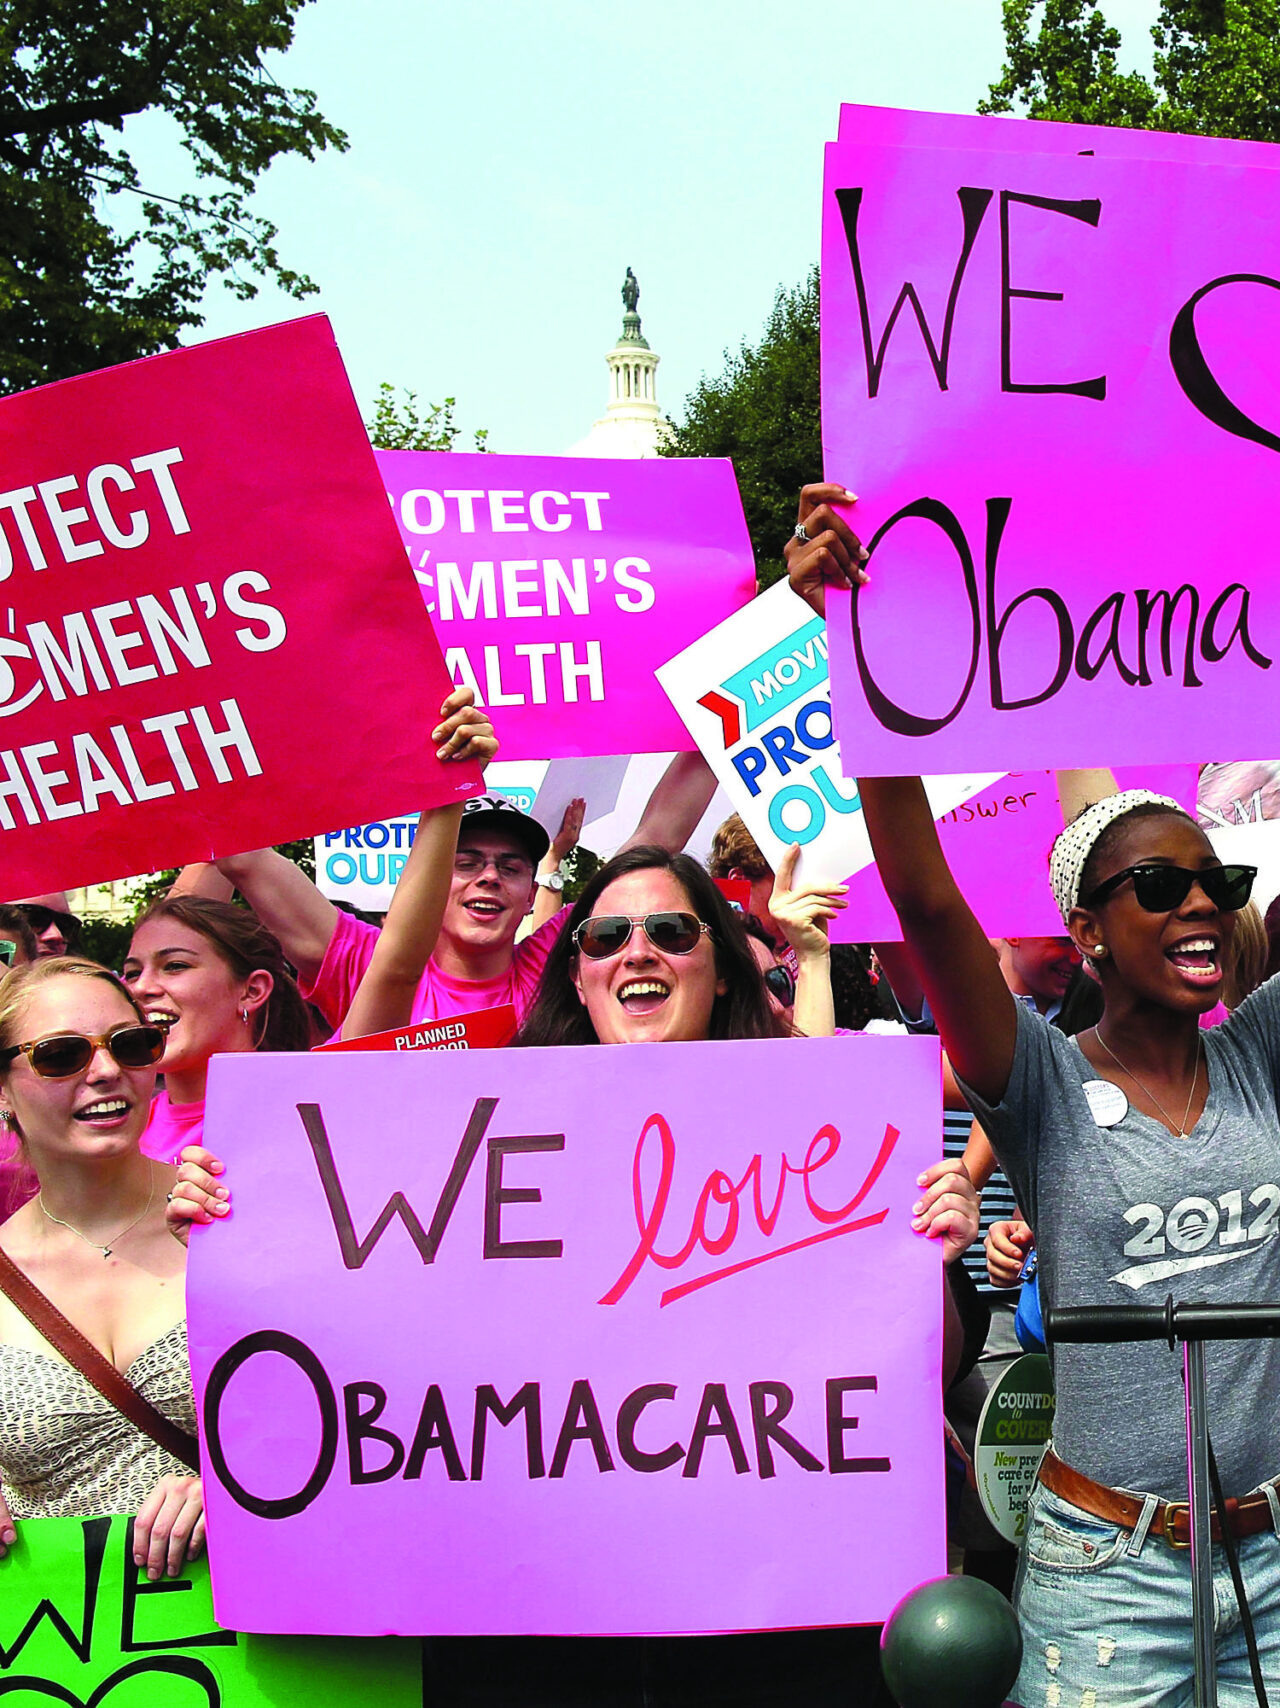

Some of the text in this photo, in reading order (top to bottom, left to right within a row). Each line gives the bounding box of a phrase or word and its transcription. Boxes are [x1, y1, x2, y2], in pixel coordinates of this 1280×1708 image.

[834, 186, 1107, 401] WE
[0, 447, 191, 582] TECT
[387, 488, 610, 535] OTECT
[405, 546, 656, 621] MEN'S
[749, 630, 829, 706] MOVI
[395, 1022, 467, 1051] PLANNED
[295, 1096, 902, 1306] WE love
[202, 1328, 892, 1520] OBAMACARE
[993, 1451, 1018, 1467] New
[998, 1469, 1022, 1481] care
[1007, 1481, 1024, 1496] for
